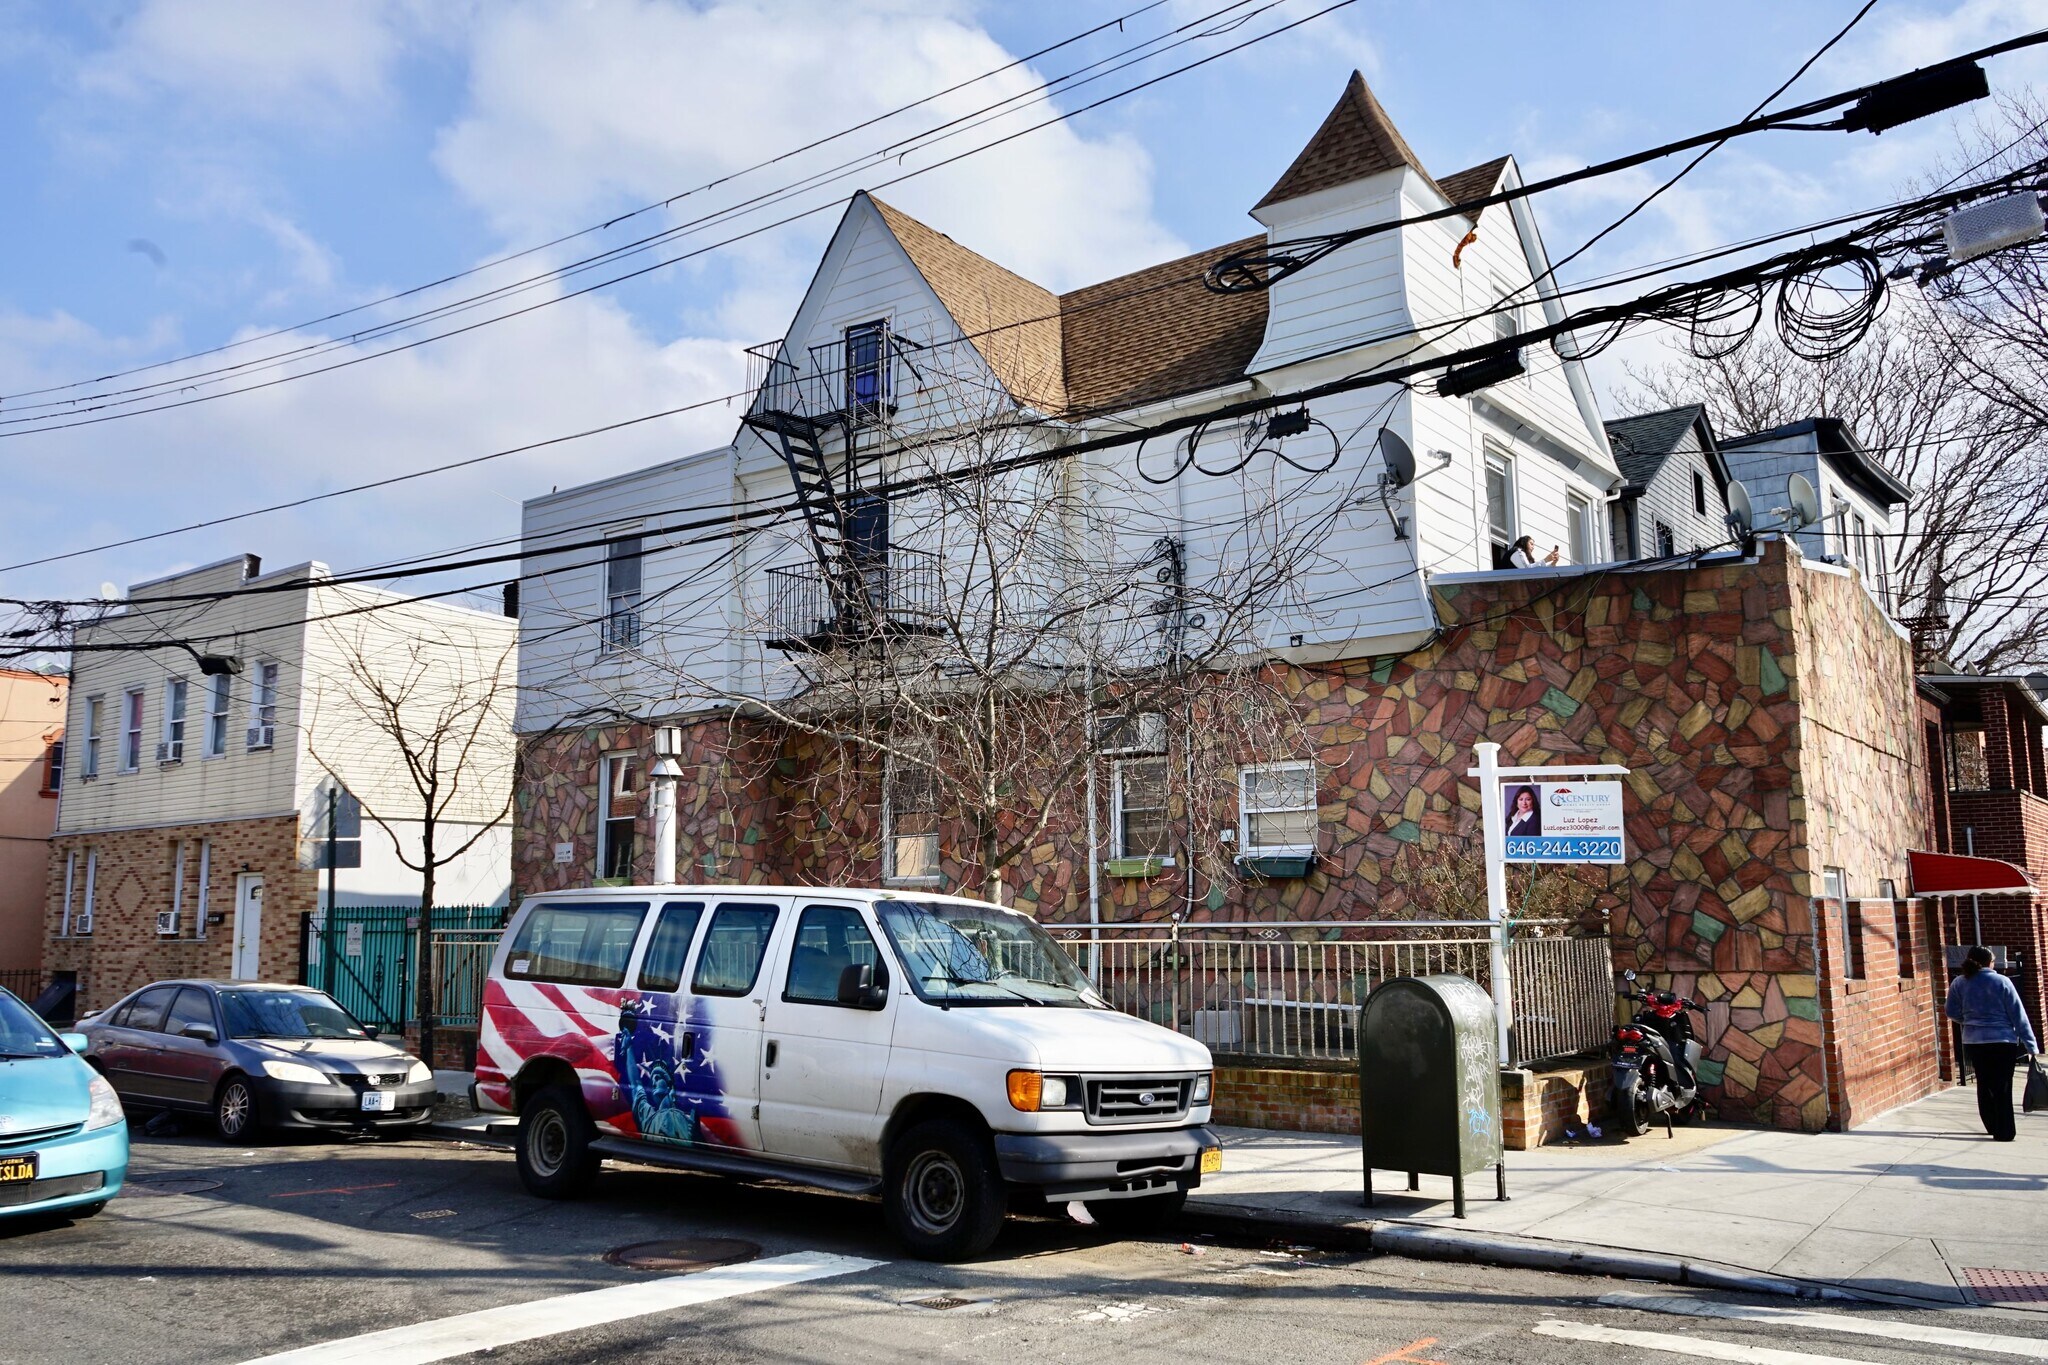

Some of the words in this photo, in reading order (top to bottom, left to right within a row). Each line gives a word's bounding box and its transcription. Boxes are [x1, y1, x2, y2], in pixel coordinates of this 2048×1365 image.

[1567, 794, 1611, 803] CENTURY
[1578, 816, 1598, 824] Lopez
[1507, 841, 1620, 856] 646-244-3220
